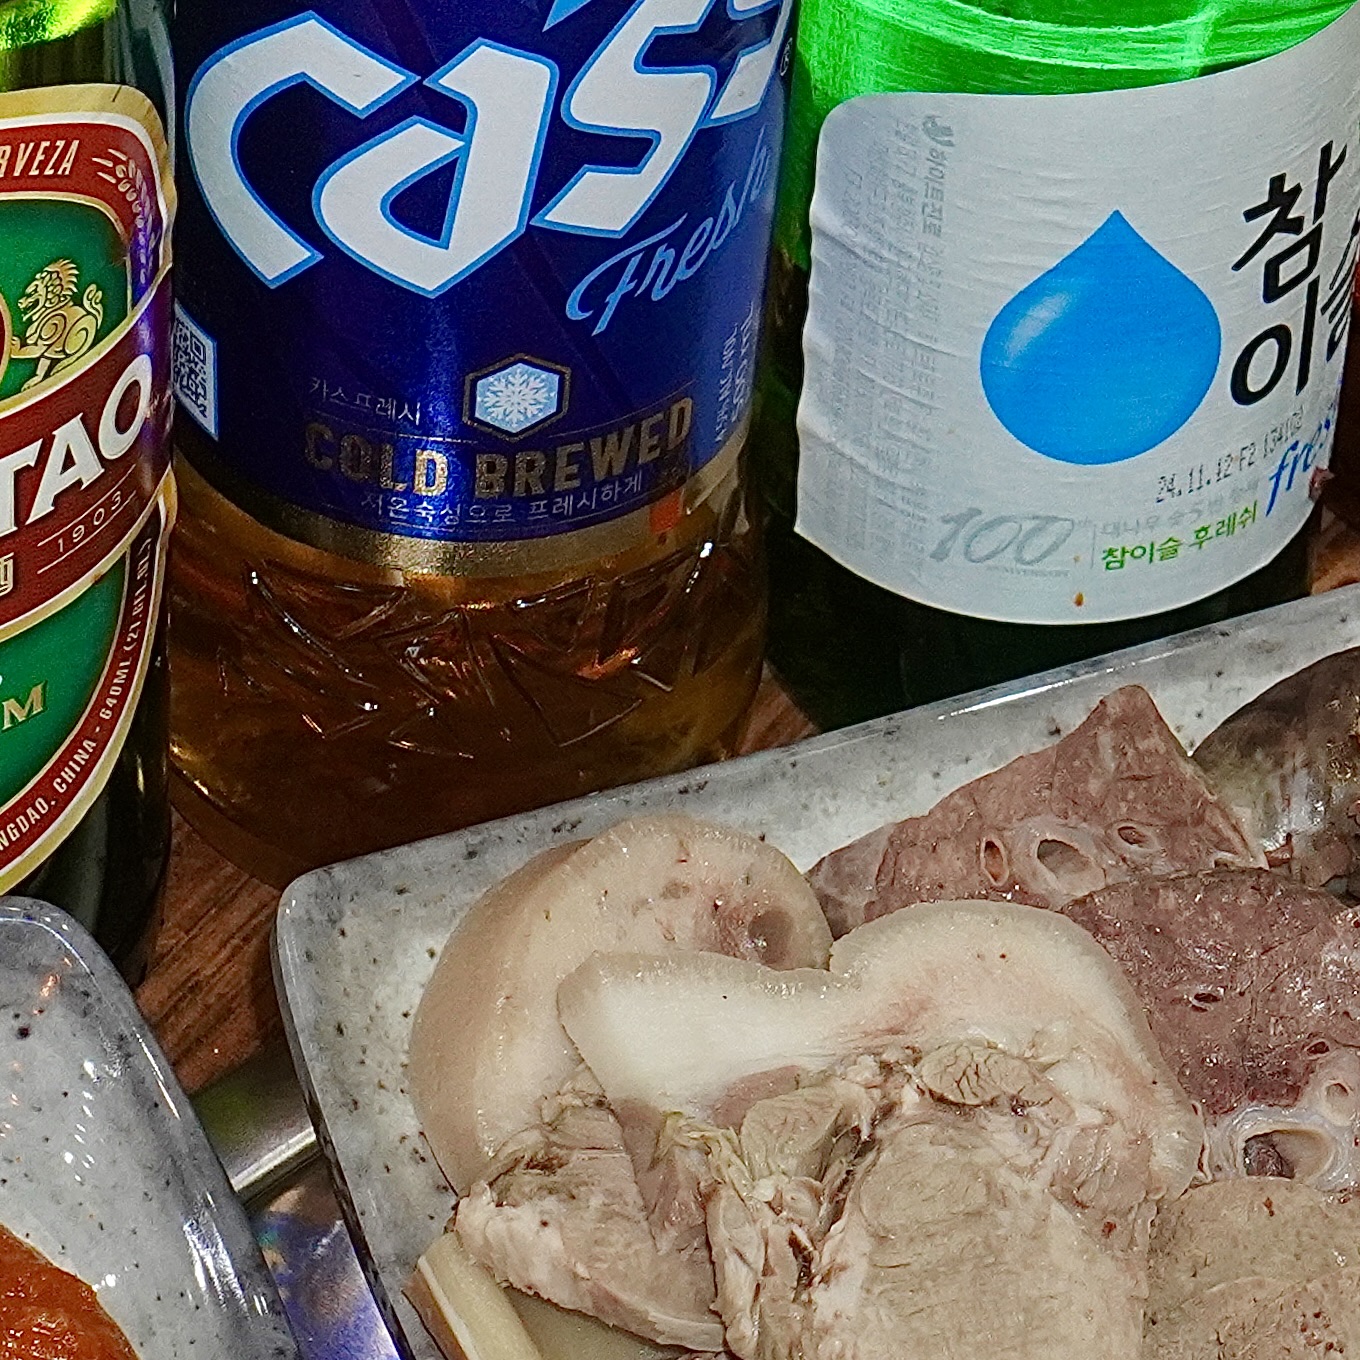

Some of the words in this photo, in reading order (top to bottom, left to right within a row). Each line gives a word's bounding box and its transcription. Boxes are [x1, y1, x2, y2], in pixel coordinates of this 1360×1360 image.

[565, 124, 771, 337] Fresh
[921, 147, 949, 238] 하이트진로
[304, 421, 449, 497] COLD
[474, 396, 694, 500] BREWED
[58, 490, 123, 553] 1903
[361, 493, 517, 526] 저온숙성으로
[527, 470, 643, 520] 프레시하게
[929, 507, 1075, 565] 100
[1101, 536, 1183, 571] 참이슬
[1188, 499, 1258, 550] 후레쉬
[53, 739, 97, 793] CHINA
[99, 656, 132, 720] 640ML
